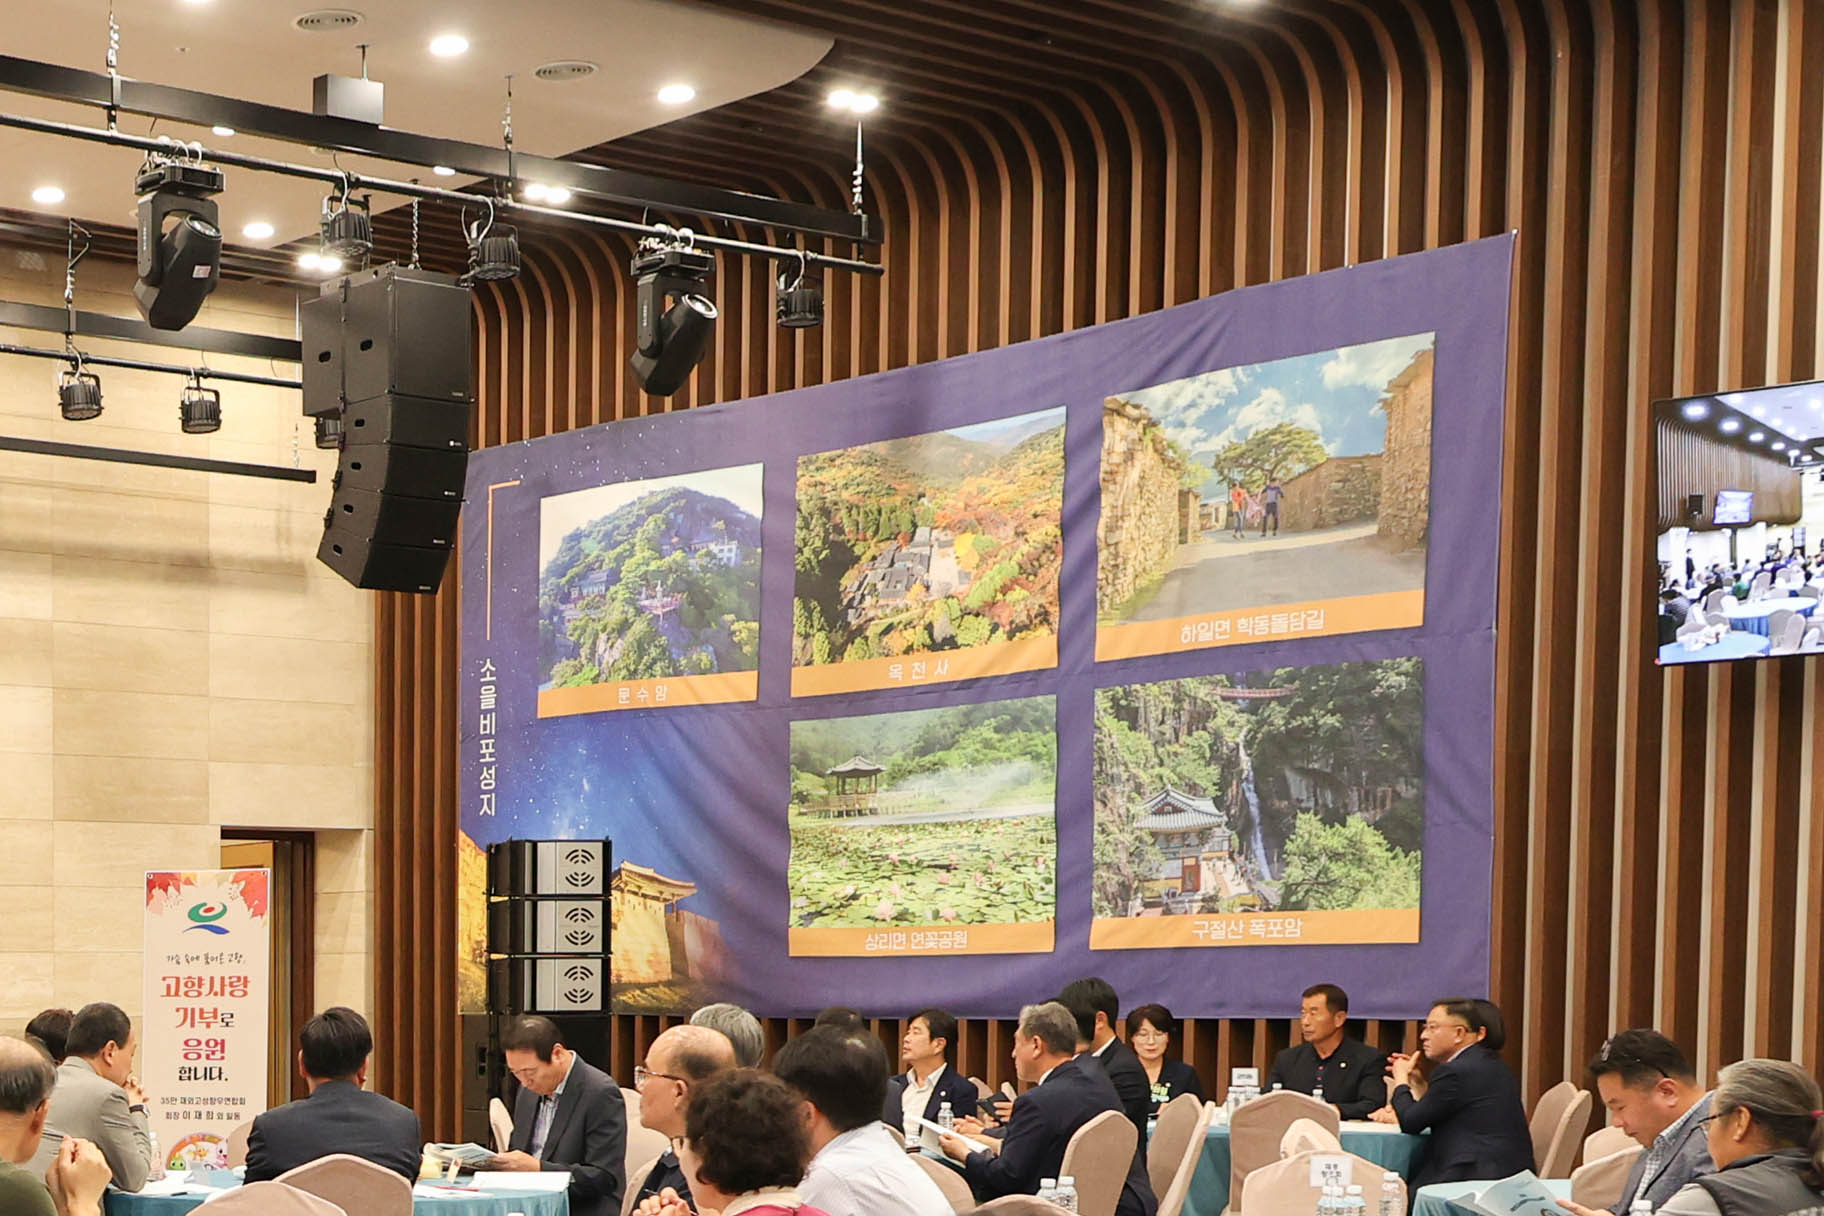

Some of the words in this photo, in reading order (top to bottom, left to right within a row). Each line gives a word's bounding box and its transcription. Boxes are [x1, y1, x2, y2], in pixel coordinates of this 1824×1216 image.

[1180, 618, 1232, 645] 하일면
[477, 659, 497, 817] 소을비포성지
[1191, 919, 1245, 940] 구절산
[159, 975, 252, 999] 고향사랑
[175, 1006, 236, 1030] 기부로
[181, 1037, 227, 1062] 응원
[178, 1065, 230, 1082] 합니다.
